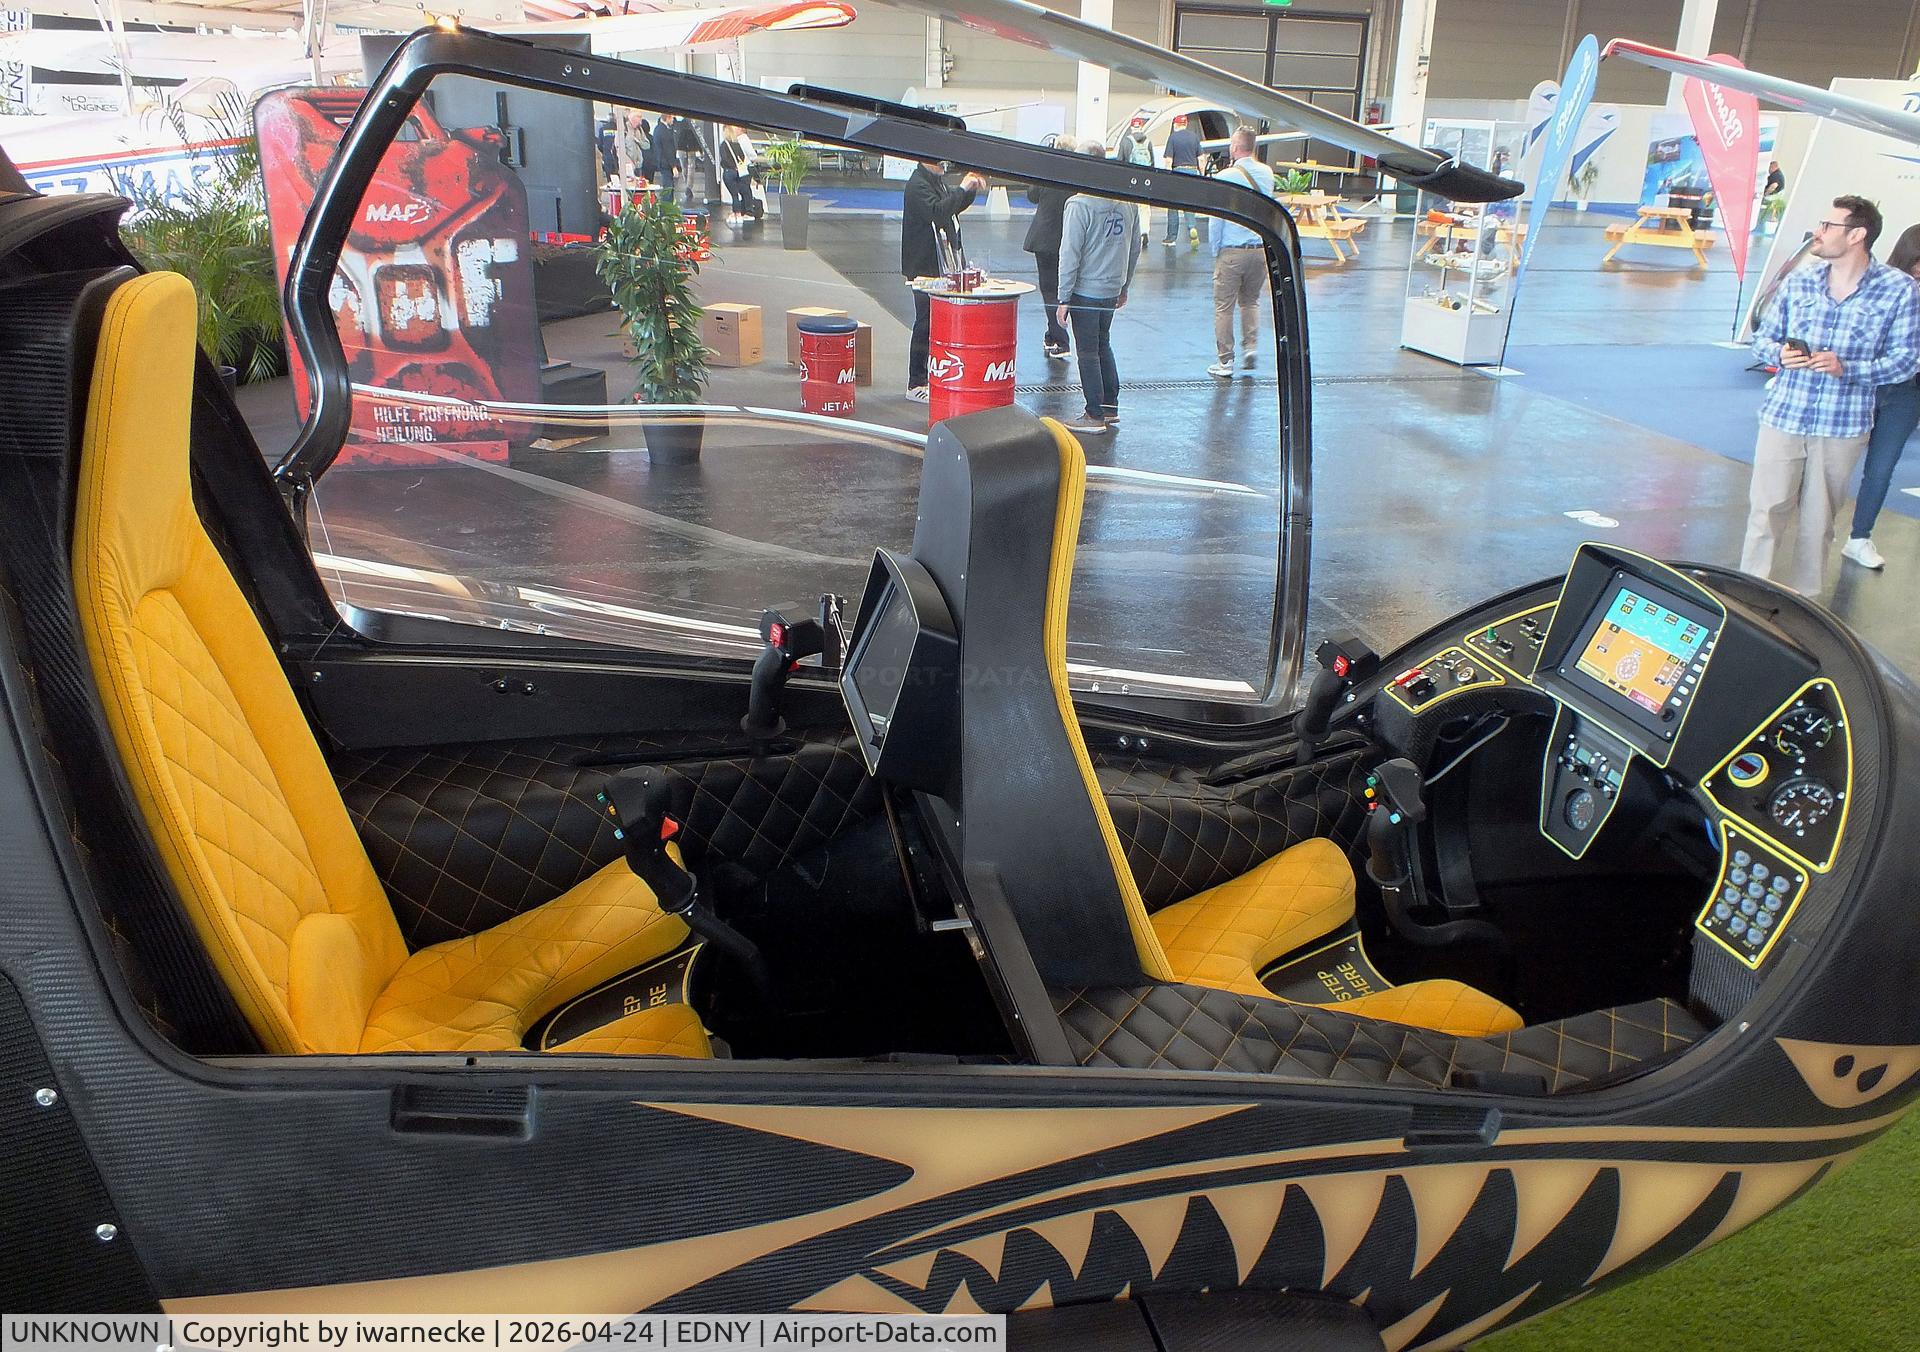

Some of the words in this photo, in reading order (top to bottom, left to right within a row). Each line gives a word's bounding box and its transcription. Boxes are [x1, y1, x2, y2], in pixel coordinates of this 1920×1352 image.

[366, 203, 419, 222] MAF
[373, 406, 416, 423] HILFE.
[821, 402, 840, 411] JET
[376, 426, 437, 442] HEILUNG.
[1317, 970, 1352, 1002] STEP
[1336, 962, 1375, 997] HERE
[650, 983, 667, 1006] RE
[624, 995, 640, 1016] EP
